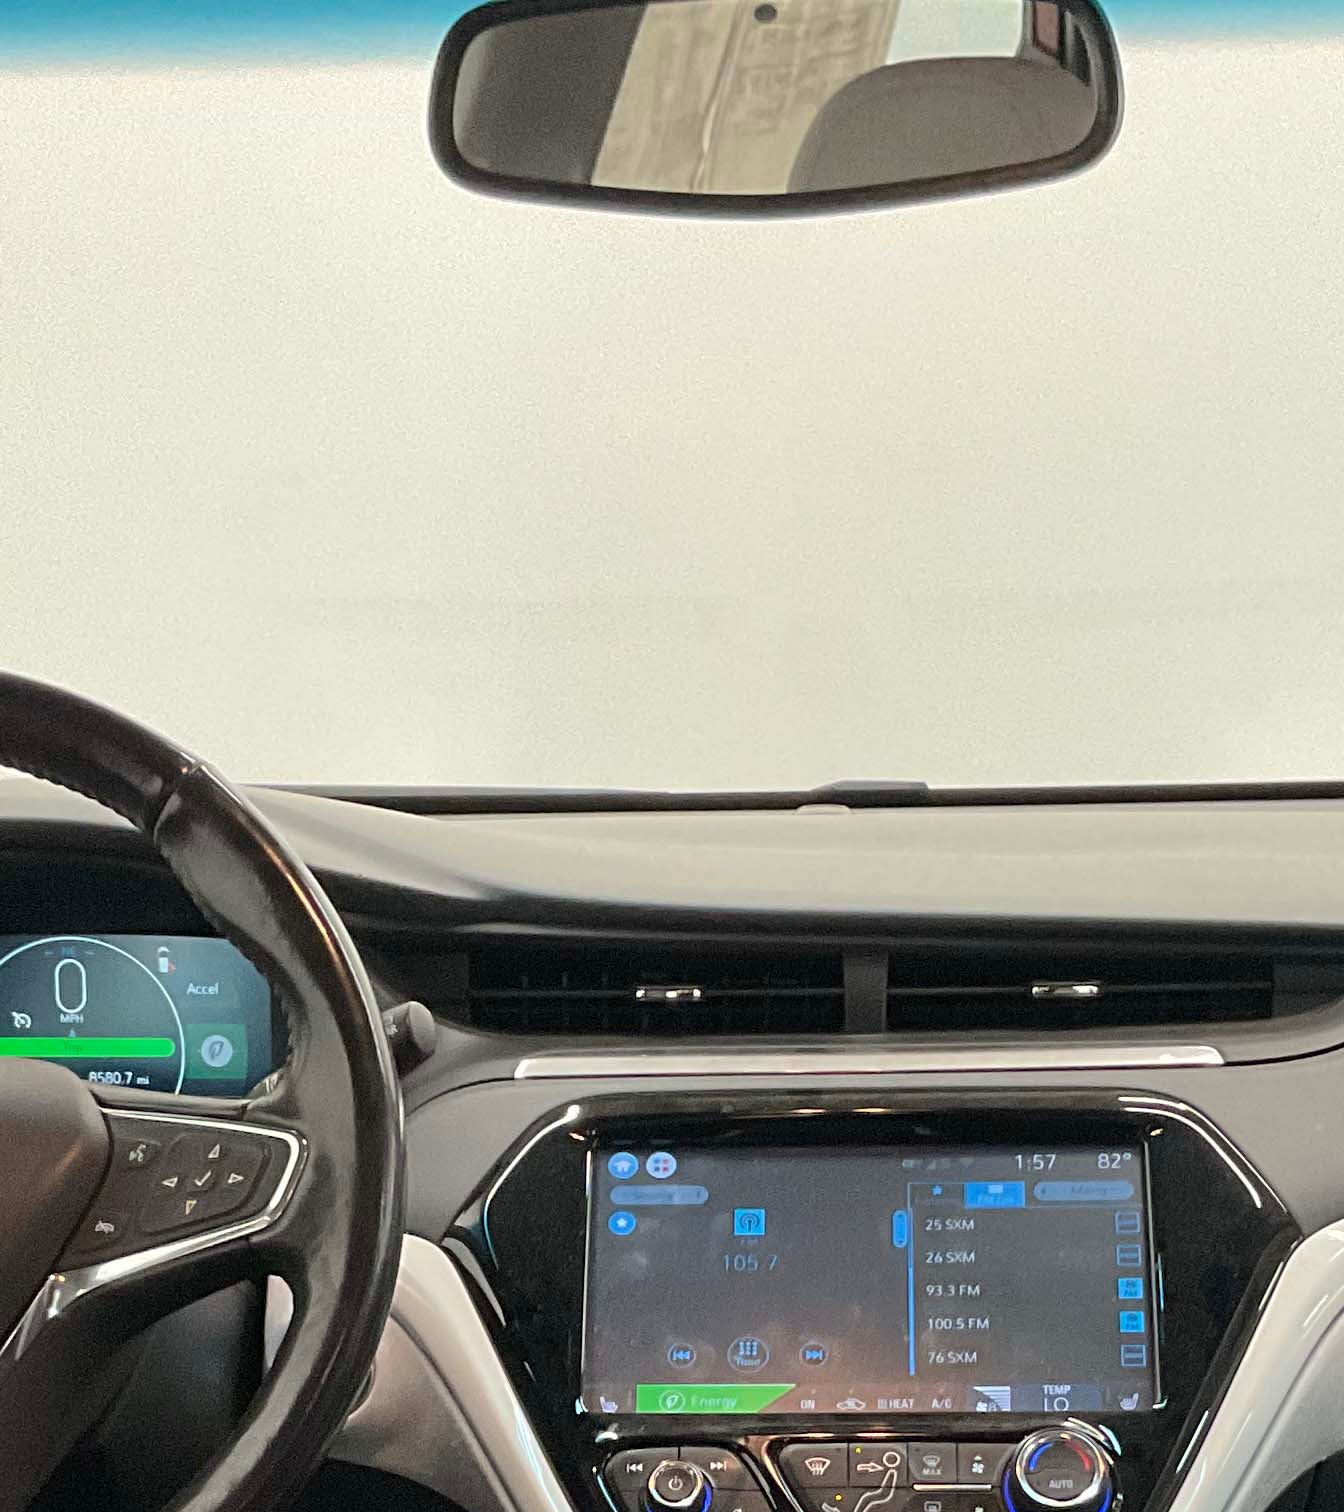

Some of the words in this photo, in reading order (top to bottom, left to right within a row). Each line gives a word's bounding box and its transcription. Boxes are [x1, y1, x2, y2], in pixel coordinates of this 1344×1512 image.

[54, 958, 87, 1014] 0
[186, 981, 219, 997] Accel
[60, 1013, 84, 1024] MPH
[1015, 1154, 1056, 1170] 1:57
[925, 1218, 942, 1231] 25
[945, 1218, 974, 1231] SXM
[925, 1251, 943, 1264] 26
[945, 1251, 976, 1264] SXM
[959, 1284, 981, 1296] FM
[968, 1317, 990, 1329] FM
[928, 1350, 945, 1364] 76
[947, 1350, 977, 1364] SXM
[1042, 1384, 1072, 1395] TEMP
[800, 1399, 816, 1410] ON
[1044, 1397, 1069, 1412] LO
[1049, 1479, 1074, 1489] AUTO
